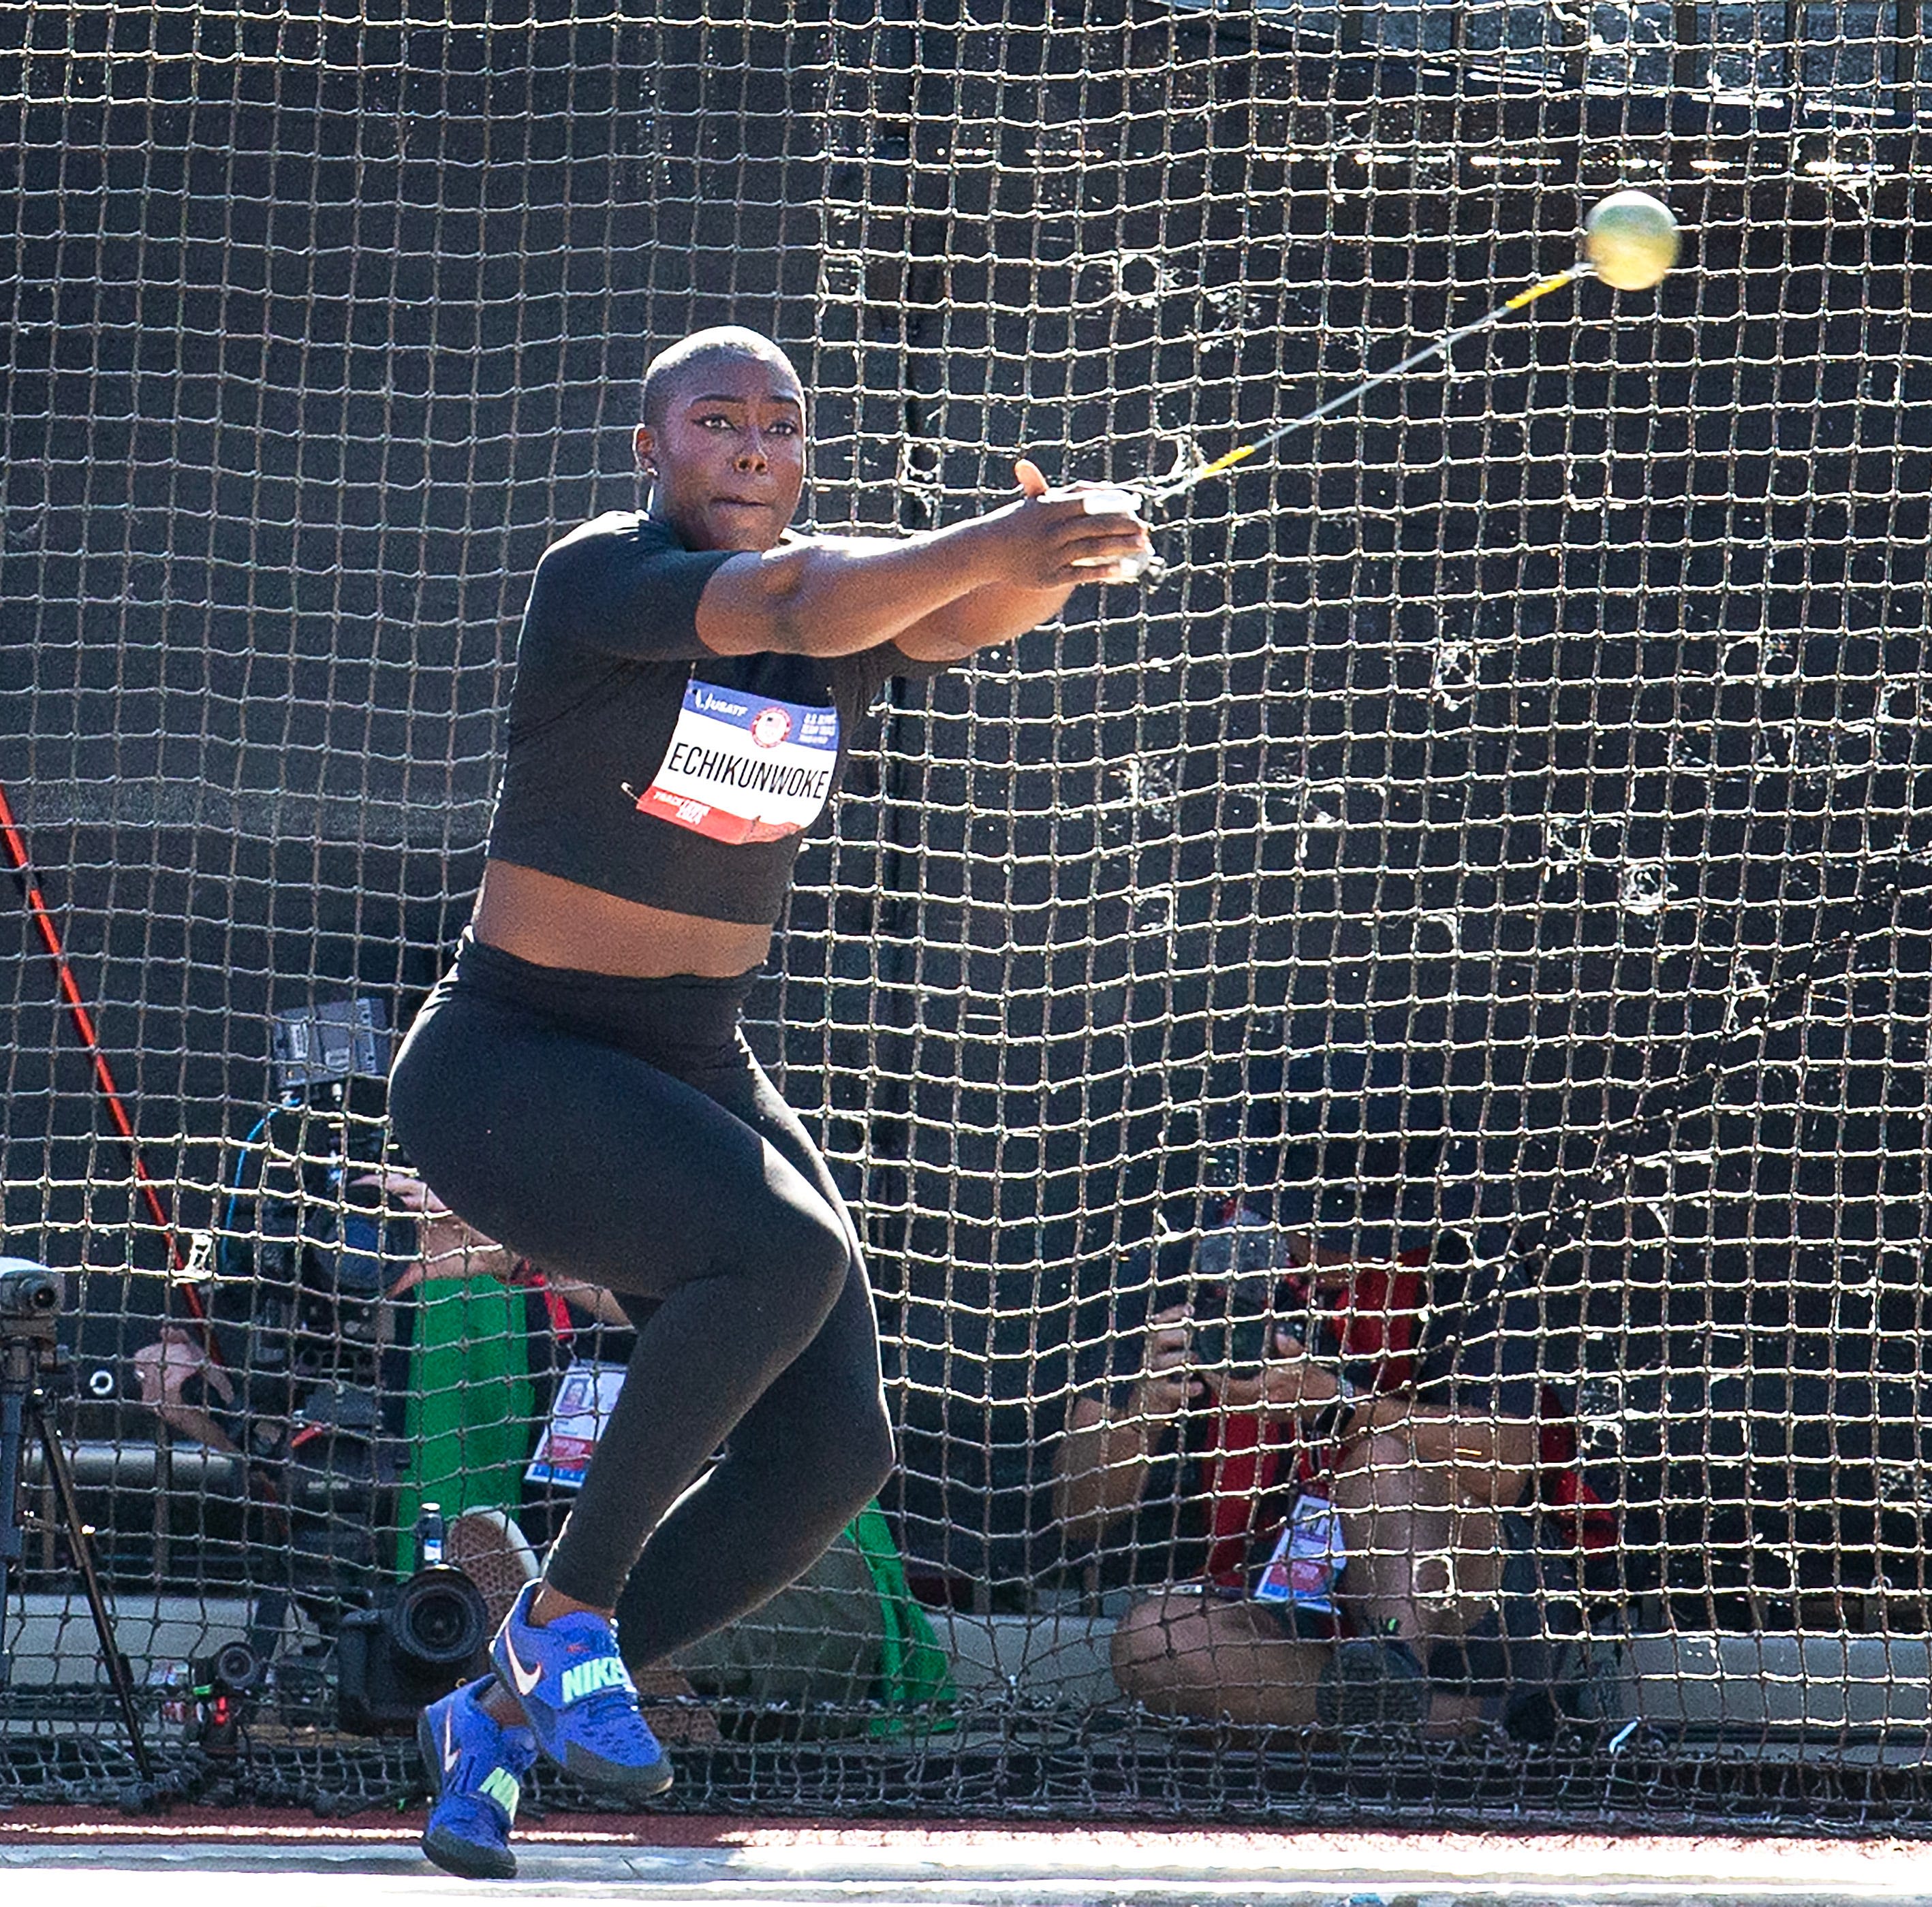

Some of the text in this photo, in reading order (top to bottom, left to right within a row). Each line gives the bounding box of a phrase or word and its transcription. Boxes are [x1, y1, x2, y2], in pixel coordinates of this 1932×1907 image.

[710, 699, 748, 716] USATF
[668, 742, 828, 799] ECHIKUNWOKE
[561, 1656, 636, 1703] NIKE
